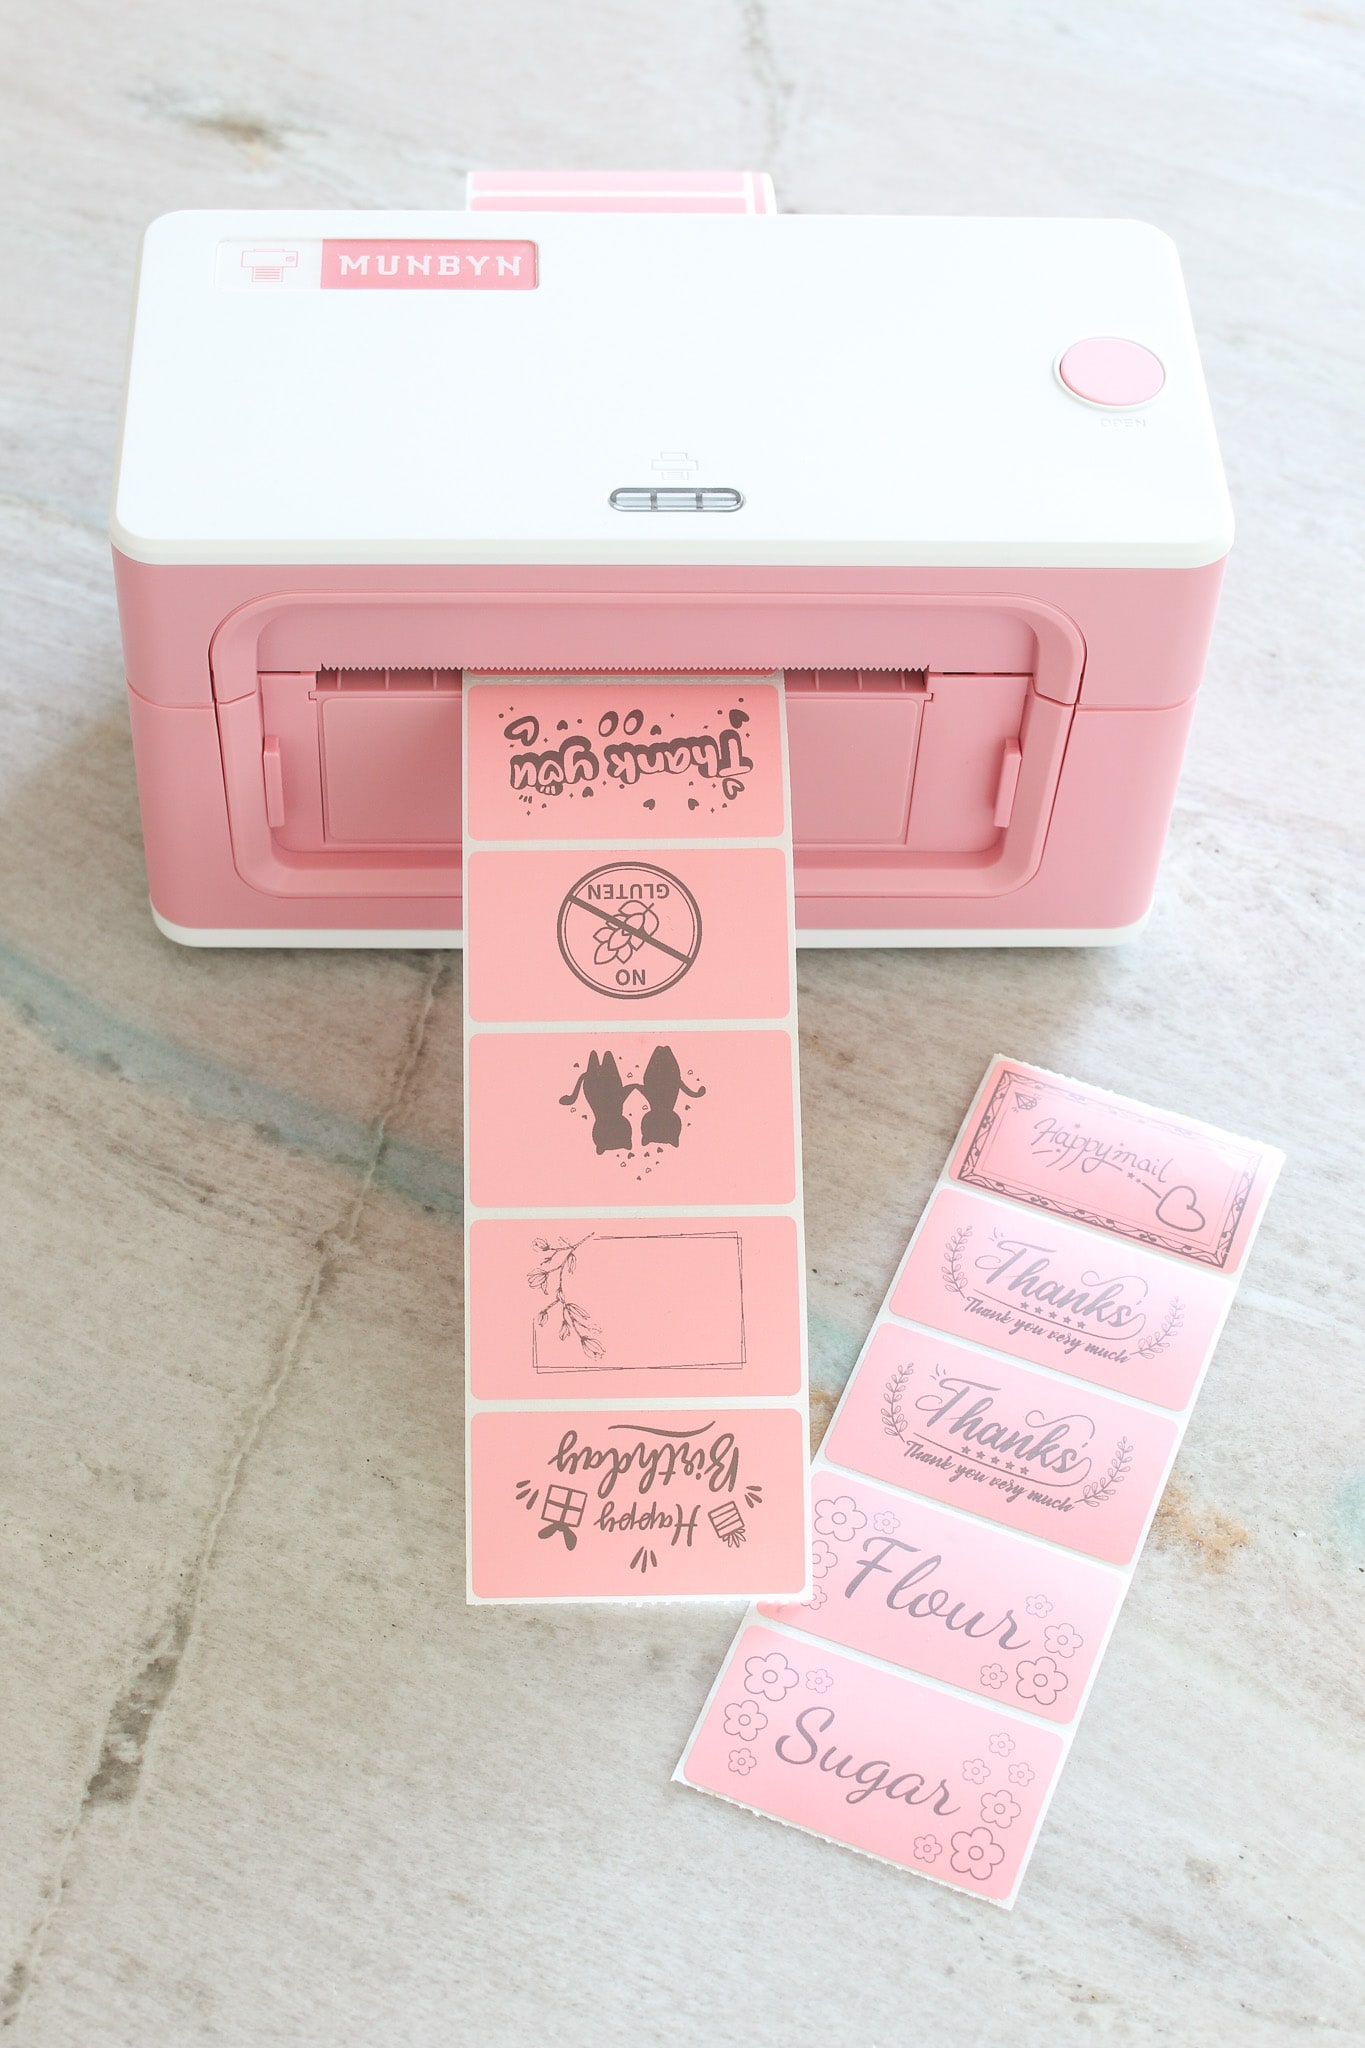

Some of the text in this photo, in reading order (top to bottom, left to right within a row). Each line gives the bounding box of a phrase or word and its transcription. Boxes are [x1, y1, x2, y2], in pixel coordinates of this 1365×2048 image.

[339, 255, 522, 276] MUNBYN
[510, 729, 753, 793] Thank you
[587, 884, 670, 900] GLUTEN
[615, 969, 646, 986] NO
[964, 1296, 1131, 1364] Thank you very much
[547, 1430, 739, 1499] Birthday
[904, 1441, 1075, 1512] Thank you very much
[593, 1501, 701, 1547] Happy
[844, 1536, 1031, 1650] Flour
[775, 1706, 961, 1816] Sugar
